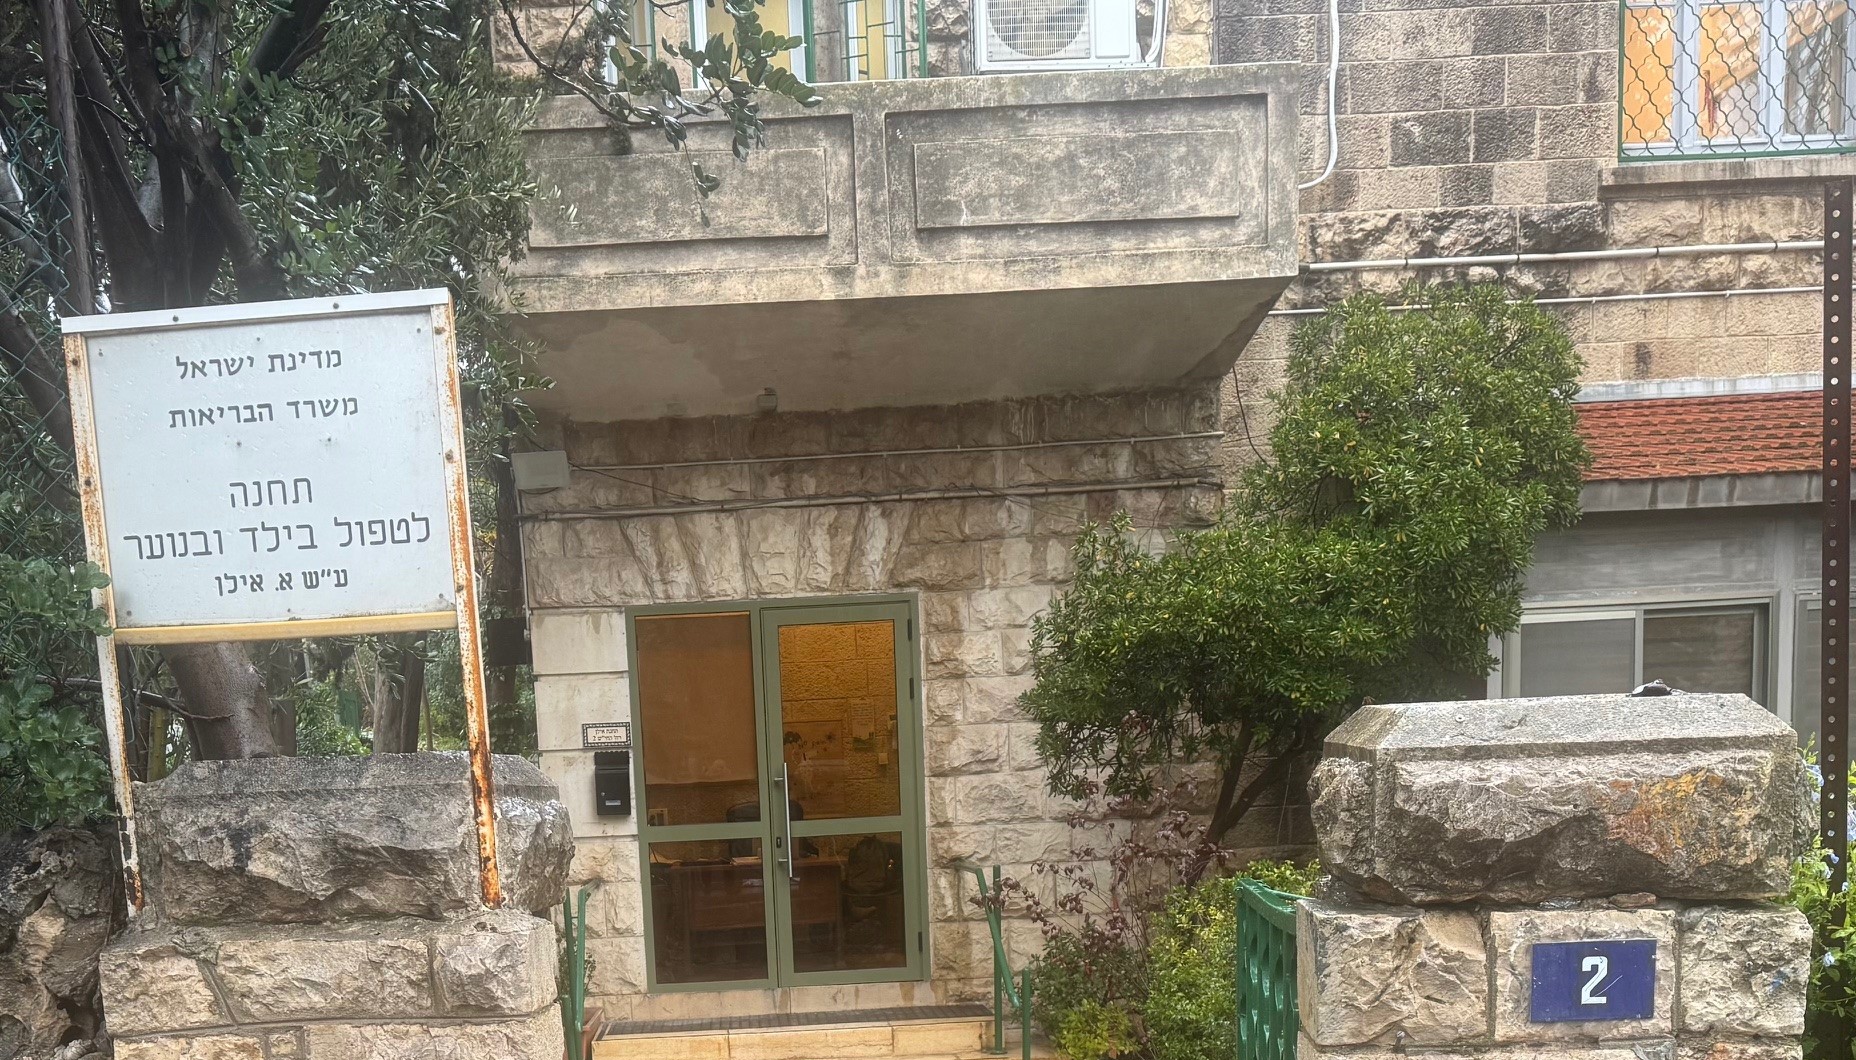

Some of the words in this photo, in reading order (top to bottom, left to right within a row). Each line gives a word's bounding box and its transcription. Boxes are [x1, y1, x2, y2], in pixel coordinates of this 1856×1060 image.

[175, 355, 255, 380] ישראל
[267, 349, 342, 373] מדינת
[168, 403, 274, 429] הבריאות
[286, 397, 358, 419] משרד
[229, 477, 313, 508] תחנה
[238, 521, 318, 553] בילד
[333, 511, 431, 548] לטפול
[123, 529, 224, 560] ובנוער
[214, 572, 264, 597] אילן
[275, 572, 294, 592] א.
[1581, 955, 1608, 1005] 2
